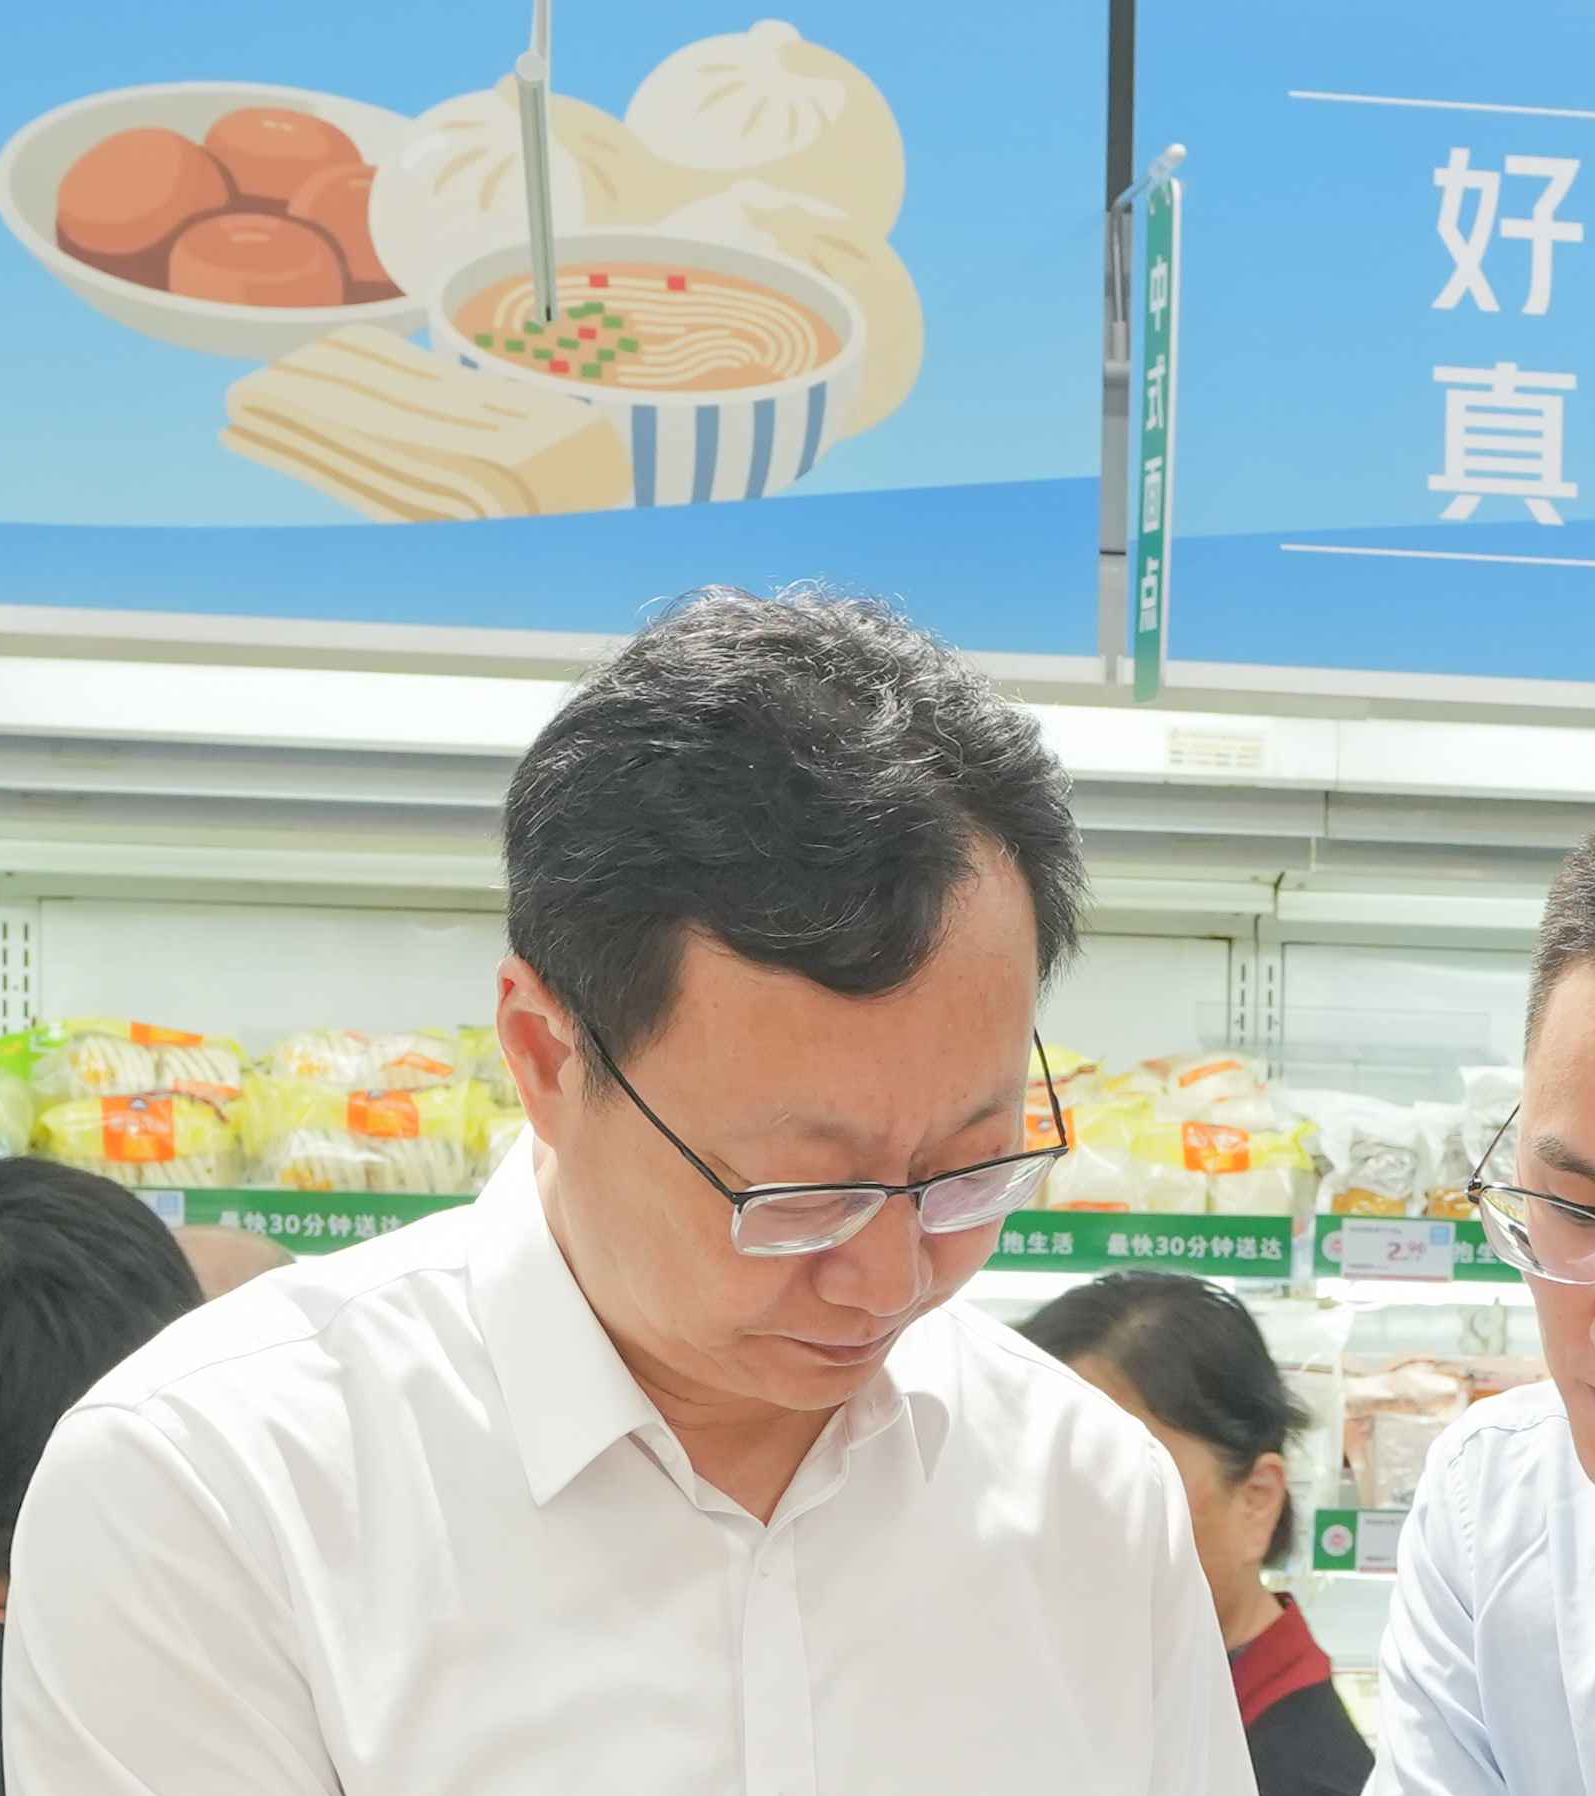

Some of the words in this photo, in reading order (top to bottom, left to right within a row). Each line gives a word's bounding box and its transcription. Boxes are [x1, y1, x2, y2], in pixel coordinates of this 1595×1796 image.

[1138, 255, 1167, 633] 中式面点
[997, 1231, 1074, 1256] 抱生活
[1107, 1232, 1283, 1261] 最快30分钟送达
